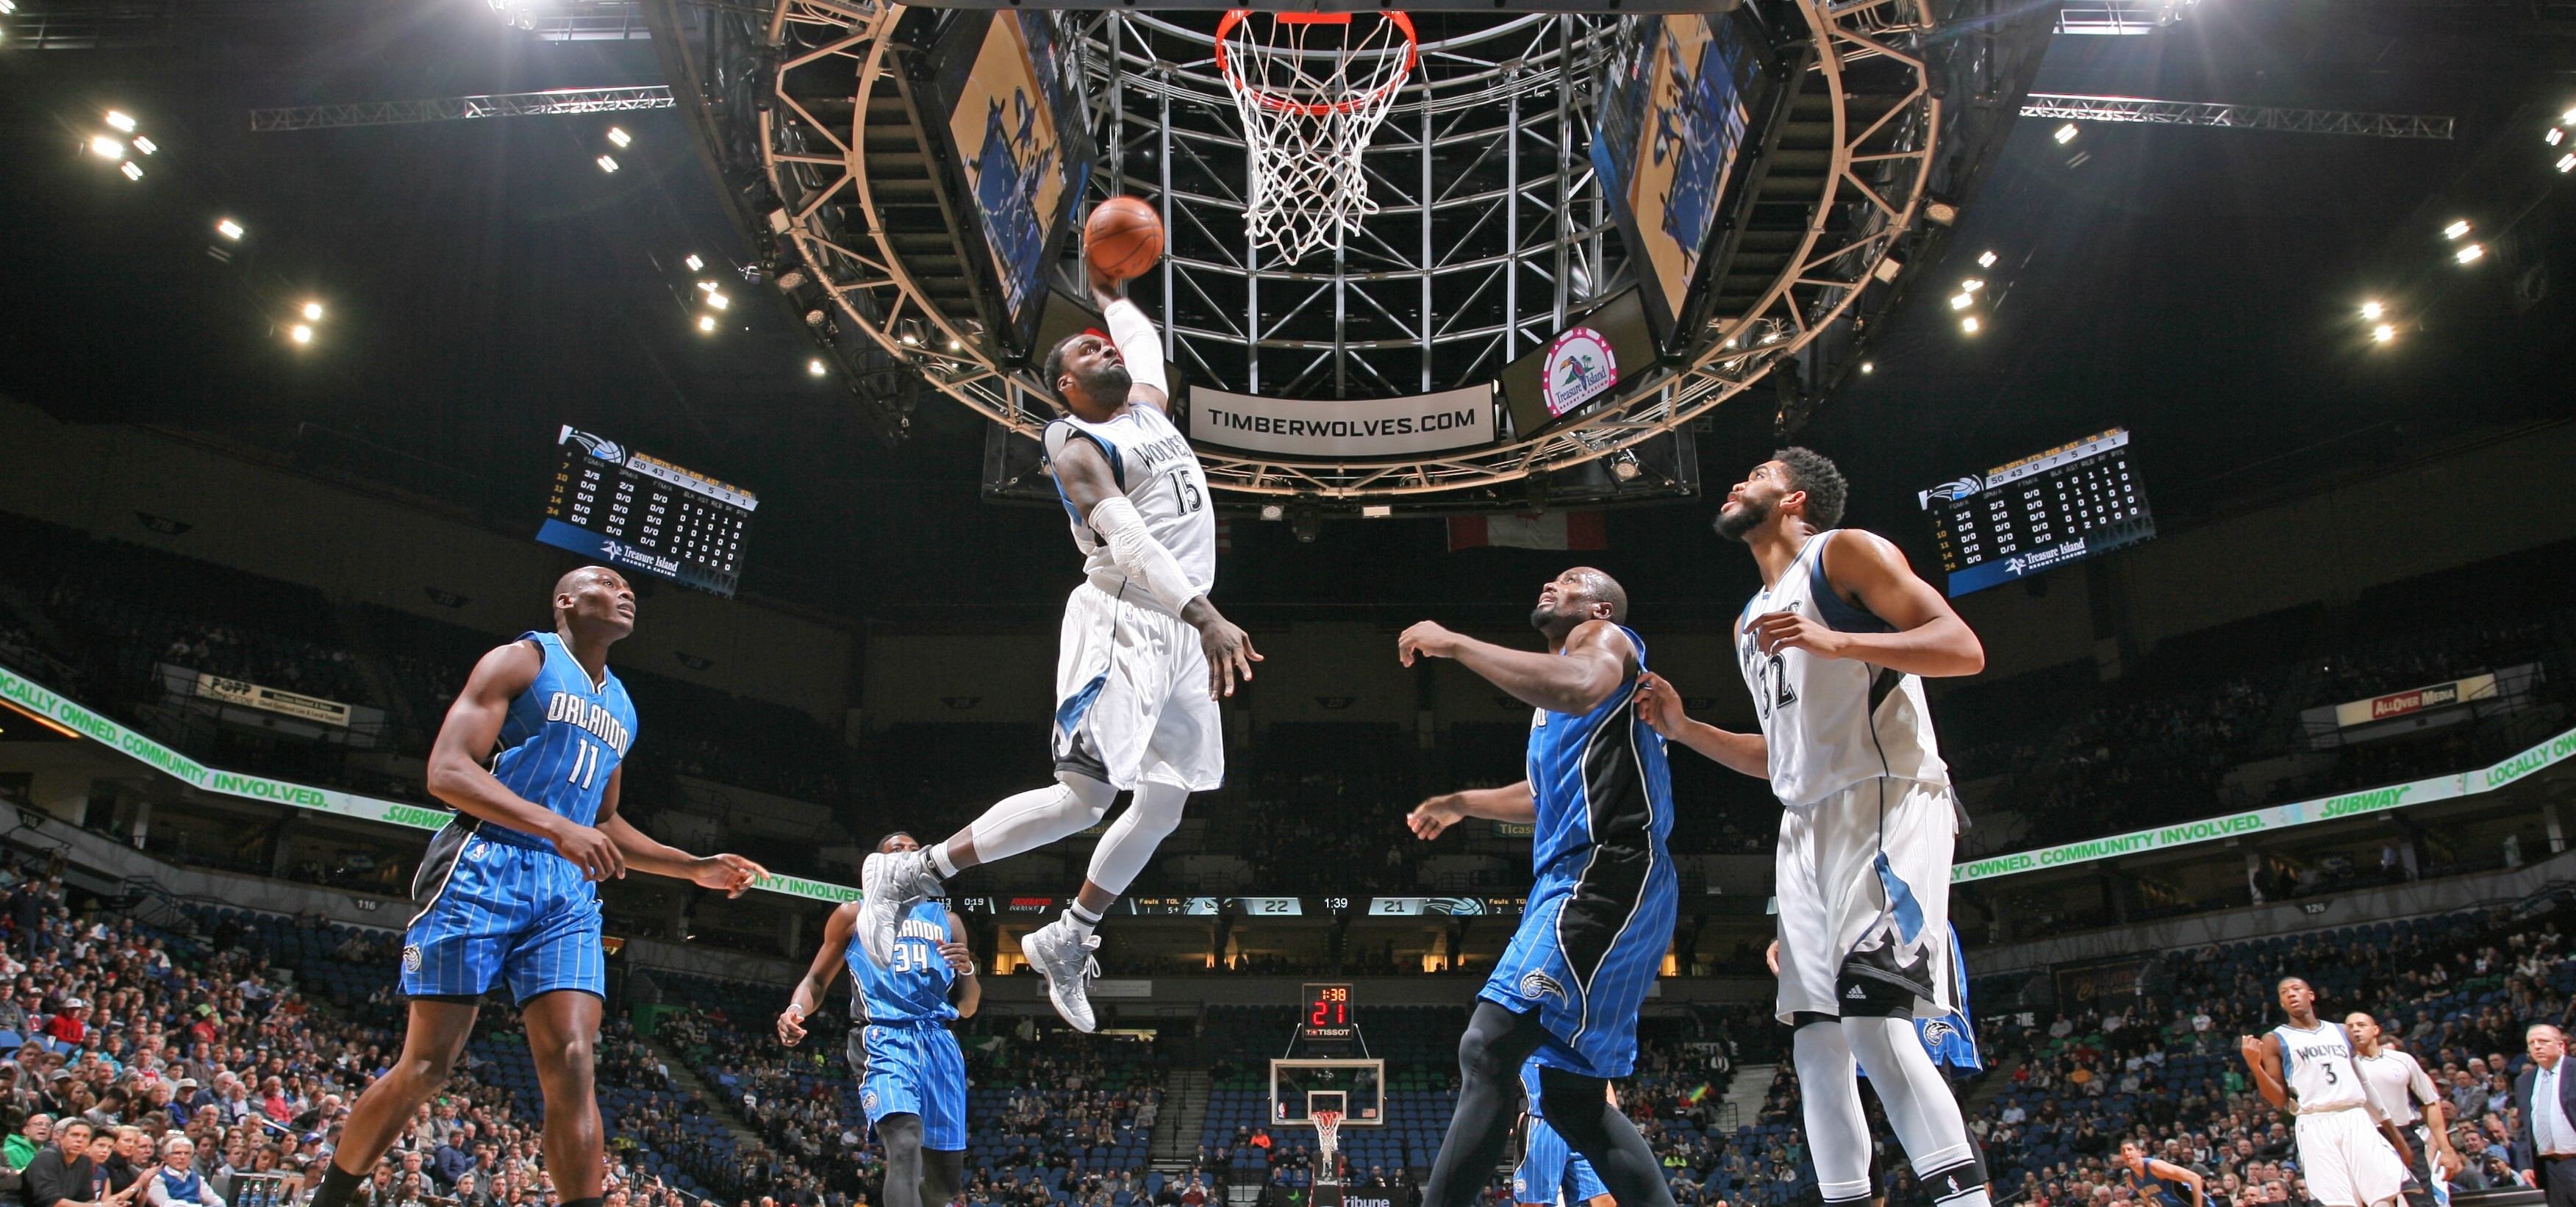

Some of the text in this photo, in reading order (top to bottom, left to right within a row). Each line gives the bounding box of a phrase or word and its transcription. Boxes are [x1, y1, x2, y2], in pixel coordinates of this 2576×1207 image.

[1555, 365, 1607, 404] Treasure Island
[1208, 408, 1475, 438] TIMBERWOLVES.COM
[2064, 442, 2079, 450] AST
[2104, 429, 2119, 437] STL
[634, 460, 646, 470] 50
[652, 468, 664, 476] 43
[1132, 434, 1192, 478] WOLVES
[584, 470, 600, 481] 3/5
[619, 482, 634, 493] 2/3
[653, 493, 668, 504] 0/0
[706, 478, 720, 486] AST
[740, 490, 753, 498] STL
[1992, 476, 2003, 484] 50
[2011, 469, 2022, 477] 43
[554, 485, 662, 525] 11 0/0 0/0 0/0
[557, 473, 665, 515] 10 0/0 0/0 0/0
[1164, 468, 1203, 516] 15
[1956, 511, 1971, 521] 3/5
[1989, 500, 2005, 510] 2/3
[2024, 489, 2040, 499] 0/0
[547, 506, 656, 547] 34 0/0 0/0 0/0
[551, 496, 659, 536] 14 0/0 0/0 0/0
[1936, 500, 2042, 539] 10 0/0 0/0 0/0
[1961, 533, 1977, 543] 0/0
[1995, 522, 2011, 532] 0/0
[2030, 511, 2045, 521] 0/0
[1942, 522, 2048, 560] 14 0/0 0/0 0/0
[1944, 534, 2051, 570] 34 0/0 0/0 0/0
[2025, 537, 2085, 565] Treasure Island
[624, 545, 679, 572] Treasure Island
[212, 677, 251, 695] POPP
[547, 692, 629, 759] ORLANDO
[60, 704, 118, 745] OWNED.
[123, 734, 209, 784] COMMUNITY
[213, 773, 328, 809] INVOLVED.
[568, 737, 600, 791] 11
[2486, 745, 2549, 787] LOCALLY
[382, 805, 454, 828] SUBWA
[2320, 785, 2411, 820] SUBWAY
[1968, 855, 2035, 877] OWNED.
[2040, 833, 2155, 864] COMMUNITY
[2161, 814, 2266, 845] INVOLVED.
[359, 900, 376, 910] 116
[1011, 898, 1053, 906] FEDERATED
[1265, 900, 1288, 912] 22
[1324, 898, 1348, 909] 1:39
[1384, 900, 1405, 912] 21
[2305, 903, 2325, 913] 126
[894, 943, 928, 973] 34
[1323, 988, 1347, 1001] 1:38
[1312, 1001, 1345, 1025] 21
[2294, 1045, 2348, 1064] WOLVES
[2320, 1061, 2337, 1085] 3
[1342, 1195, 1389, 1207] ribune
